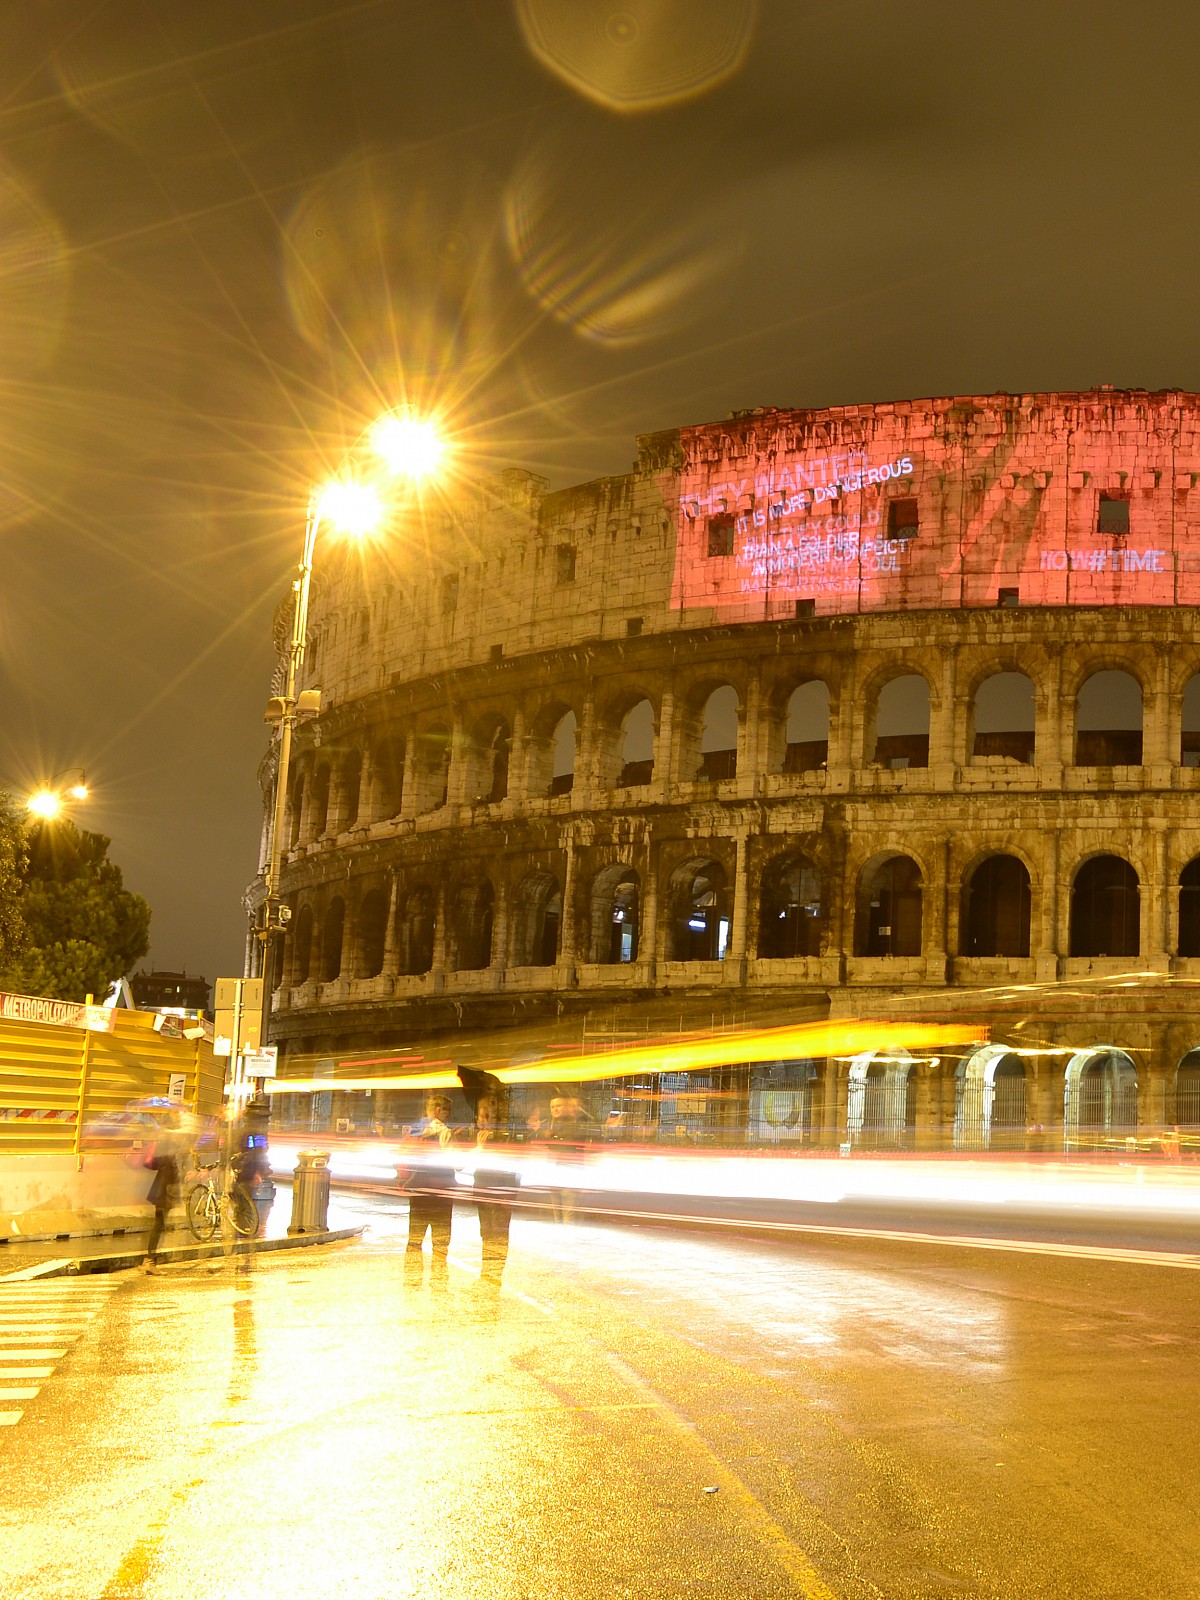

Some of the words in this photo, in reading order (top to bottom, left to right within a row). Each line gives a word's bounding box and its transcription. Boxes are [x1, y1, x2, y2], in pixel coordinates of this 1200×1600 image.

[679, 478, 747, 519] THEY
[754, 449, 868, 499] WANTED
[737, 516, 748, 535] IT
[752, 510, 766, 528] IS
[769, 492, 808, 520] MORE
[814, 457, 914, 503] DANGEROUS
[825, 510, 880, 533] COULD
[742, 540, 781, 558] THAN
[799, 532, 860, 553] SOLDIER
[769, 549, 831, 573] MODERN
[834, 538, 909, 561] CONFLICT
[861, 555, 901, 572] SOUL
